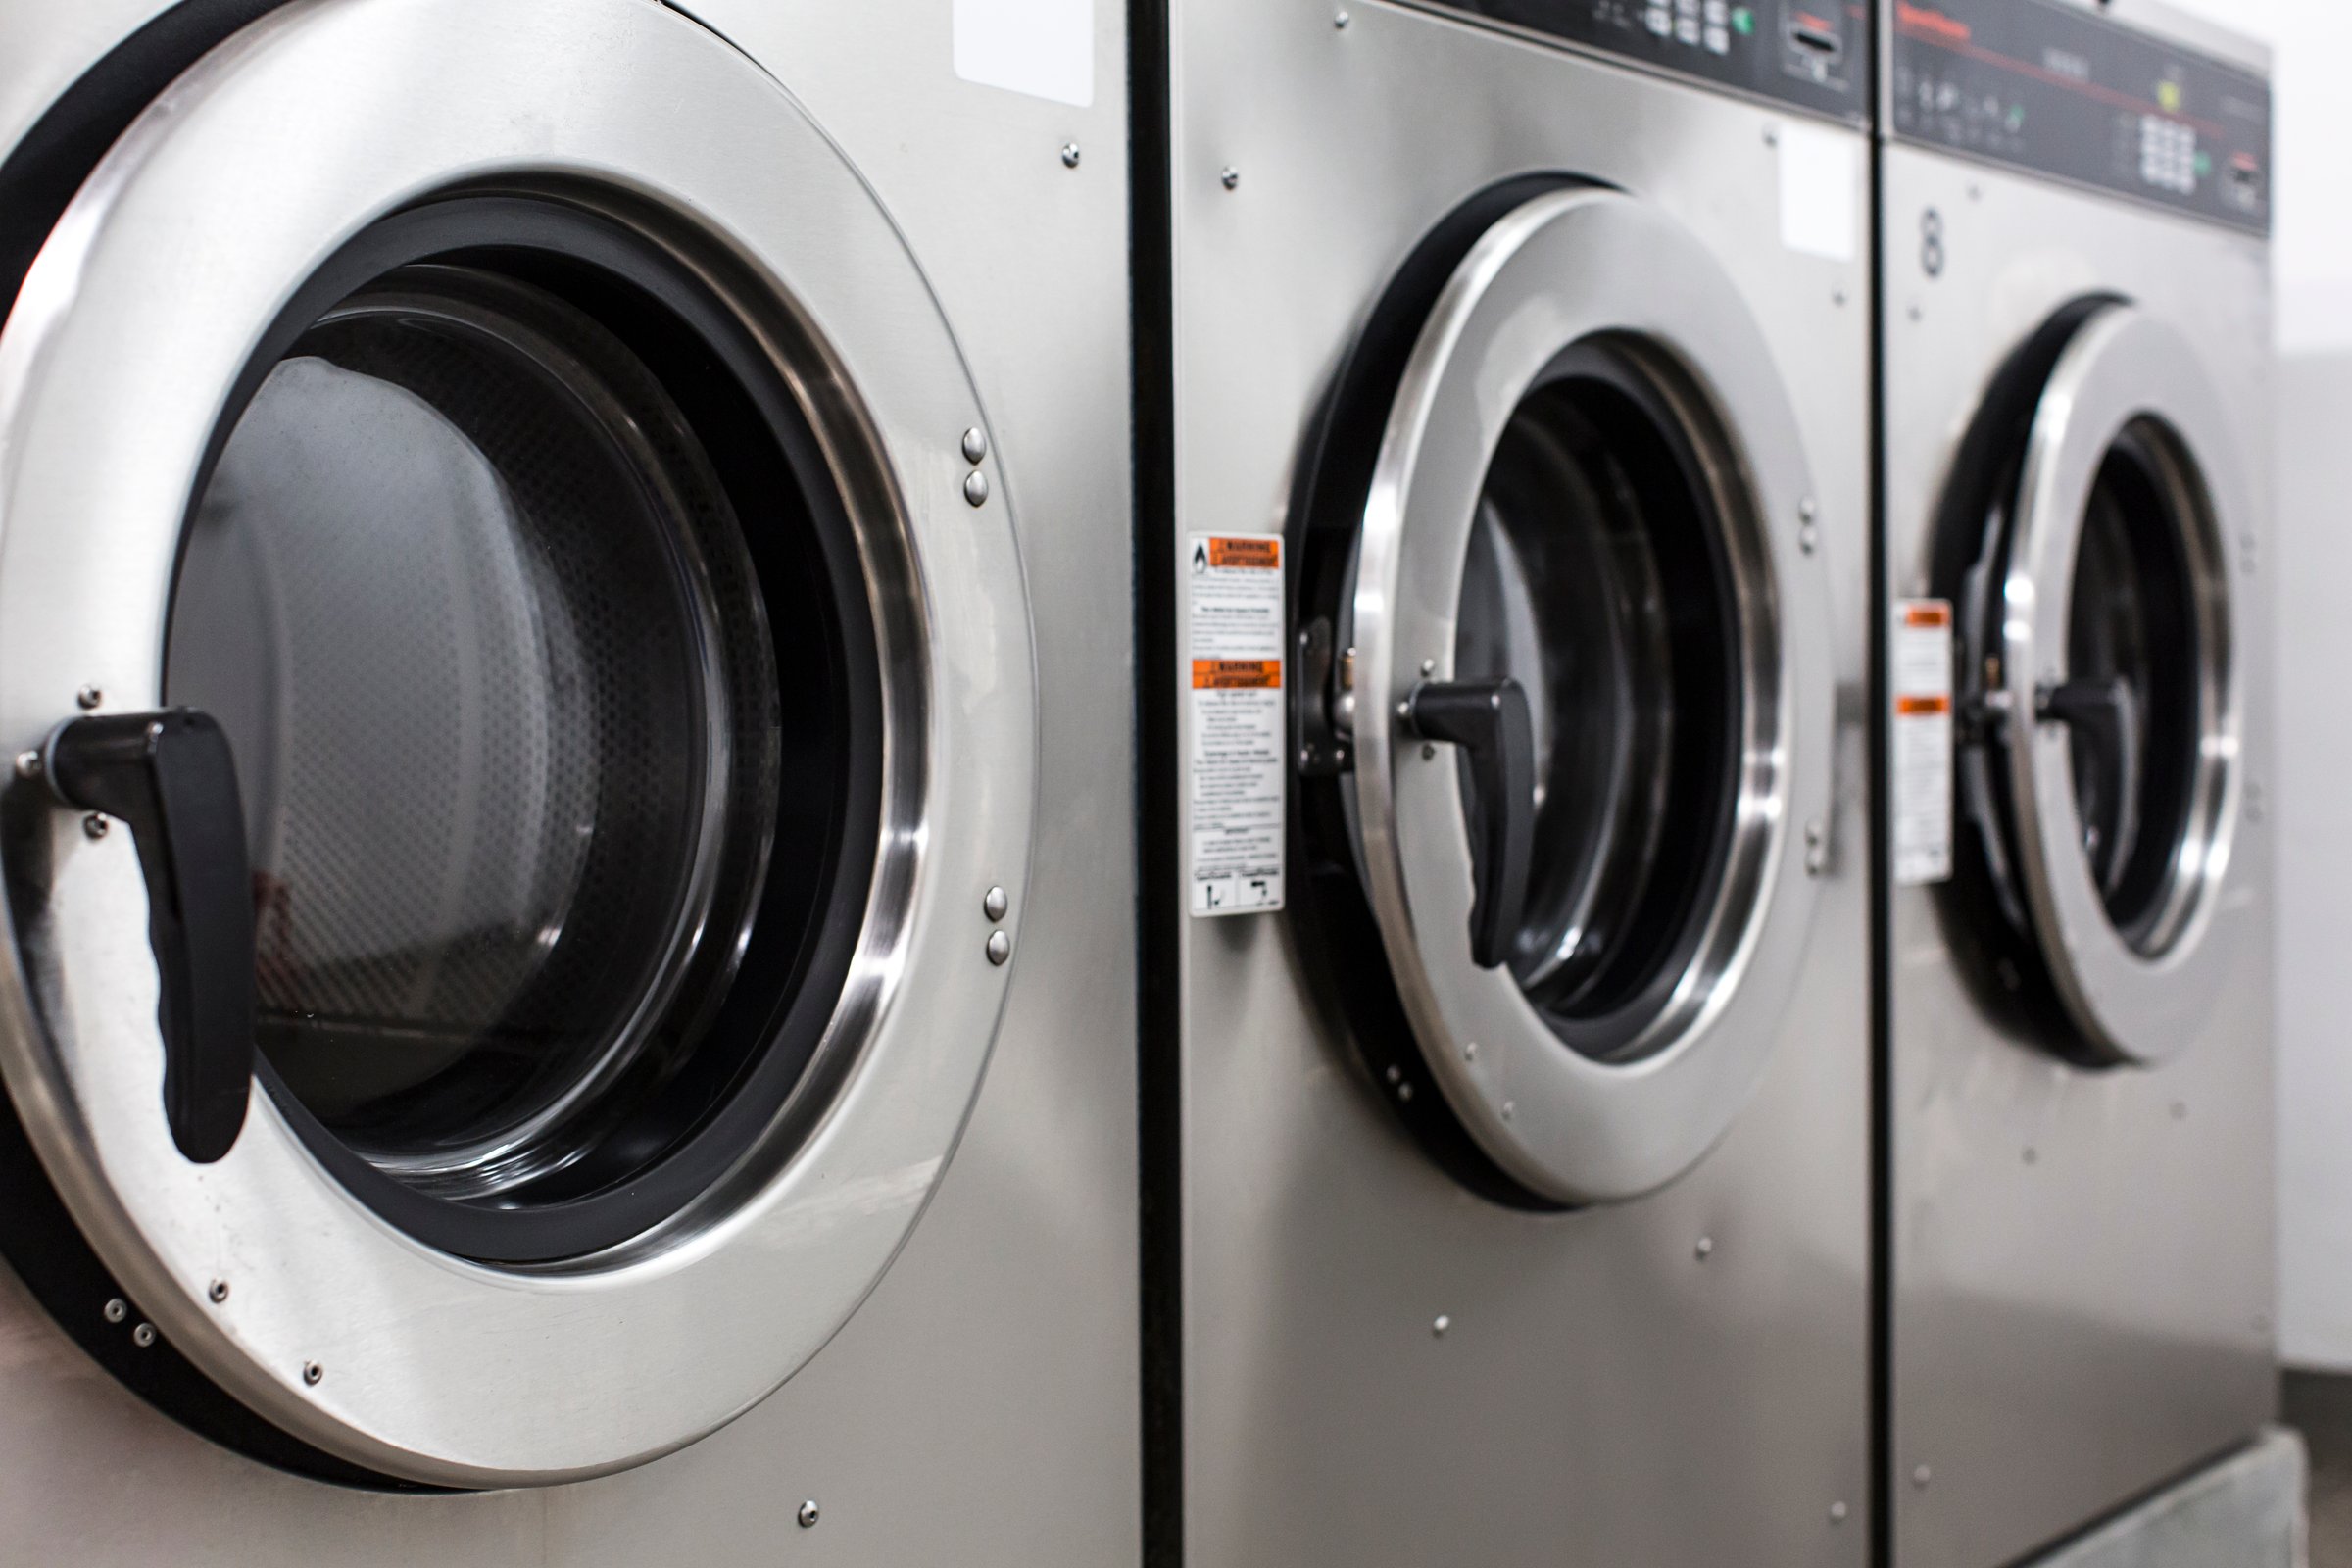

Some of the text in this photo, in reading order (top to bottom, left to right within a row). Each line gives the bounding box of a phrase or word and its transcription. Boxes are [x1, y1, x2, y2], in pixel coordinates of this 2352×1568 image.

[1920, 206, 1944, 278] 8
[1227, 541, 1271, 553] WARNING
[1219, 662, 1263, 673] WARNING
